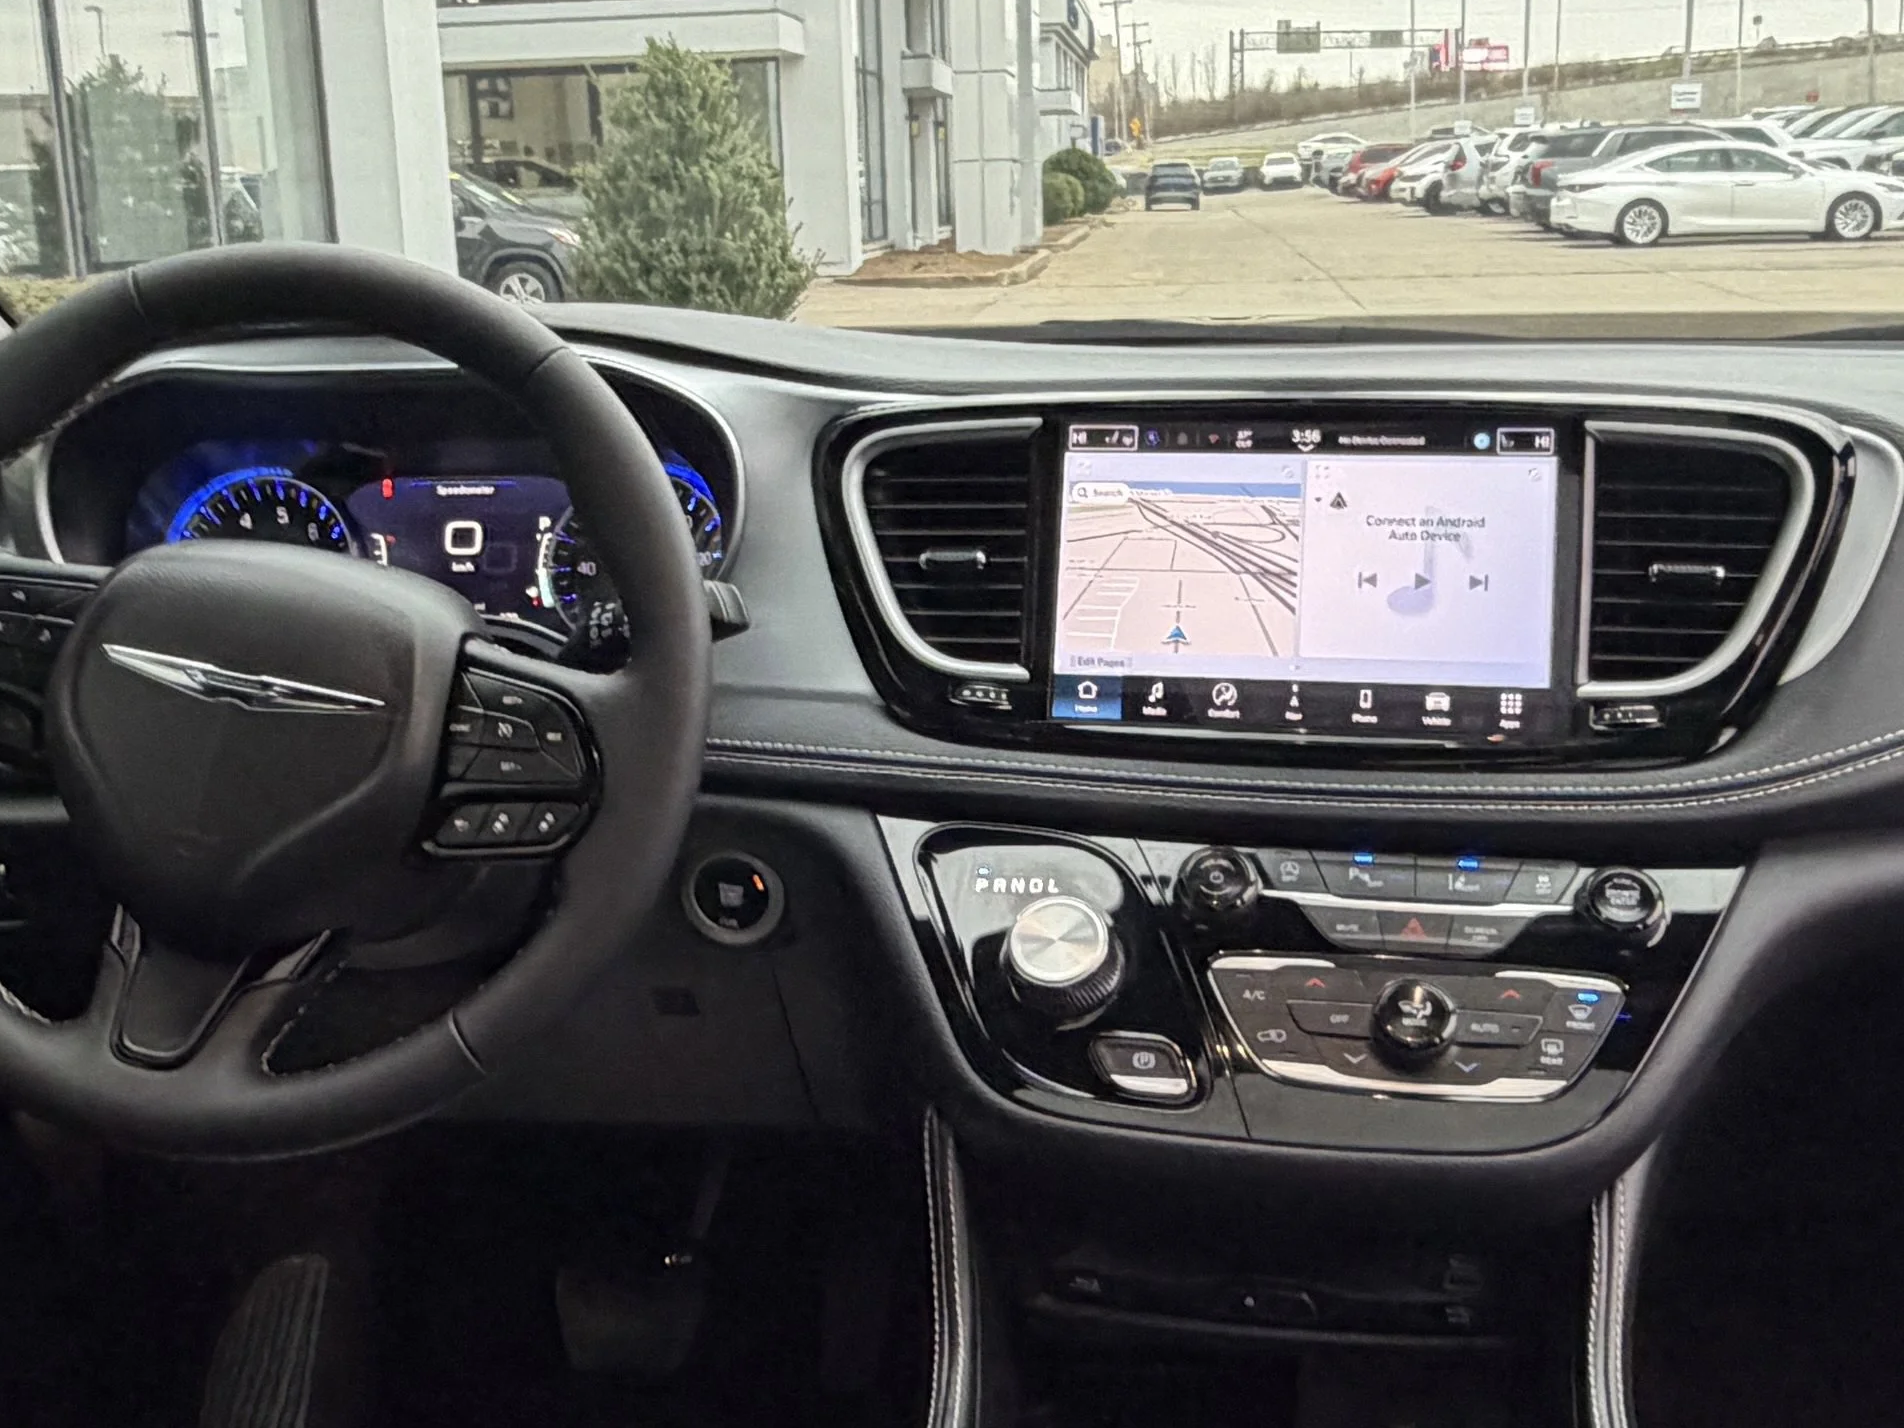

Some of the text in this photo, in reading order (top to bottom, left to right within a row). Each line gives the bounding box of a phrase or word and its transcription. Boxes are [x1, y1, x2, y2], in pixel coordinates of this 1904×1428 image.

[1366, 516, 1486, 528] Connect an Android
[1388, 530, 1461, 541] Auto Device
